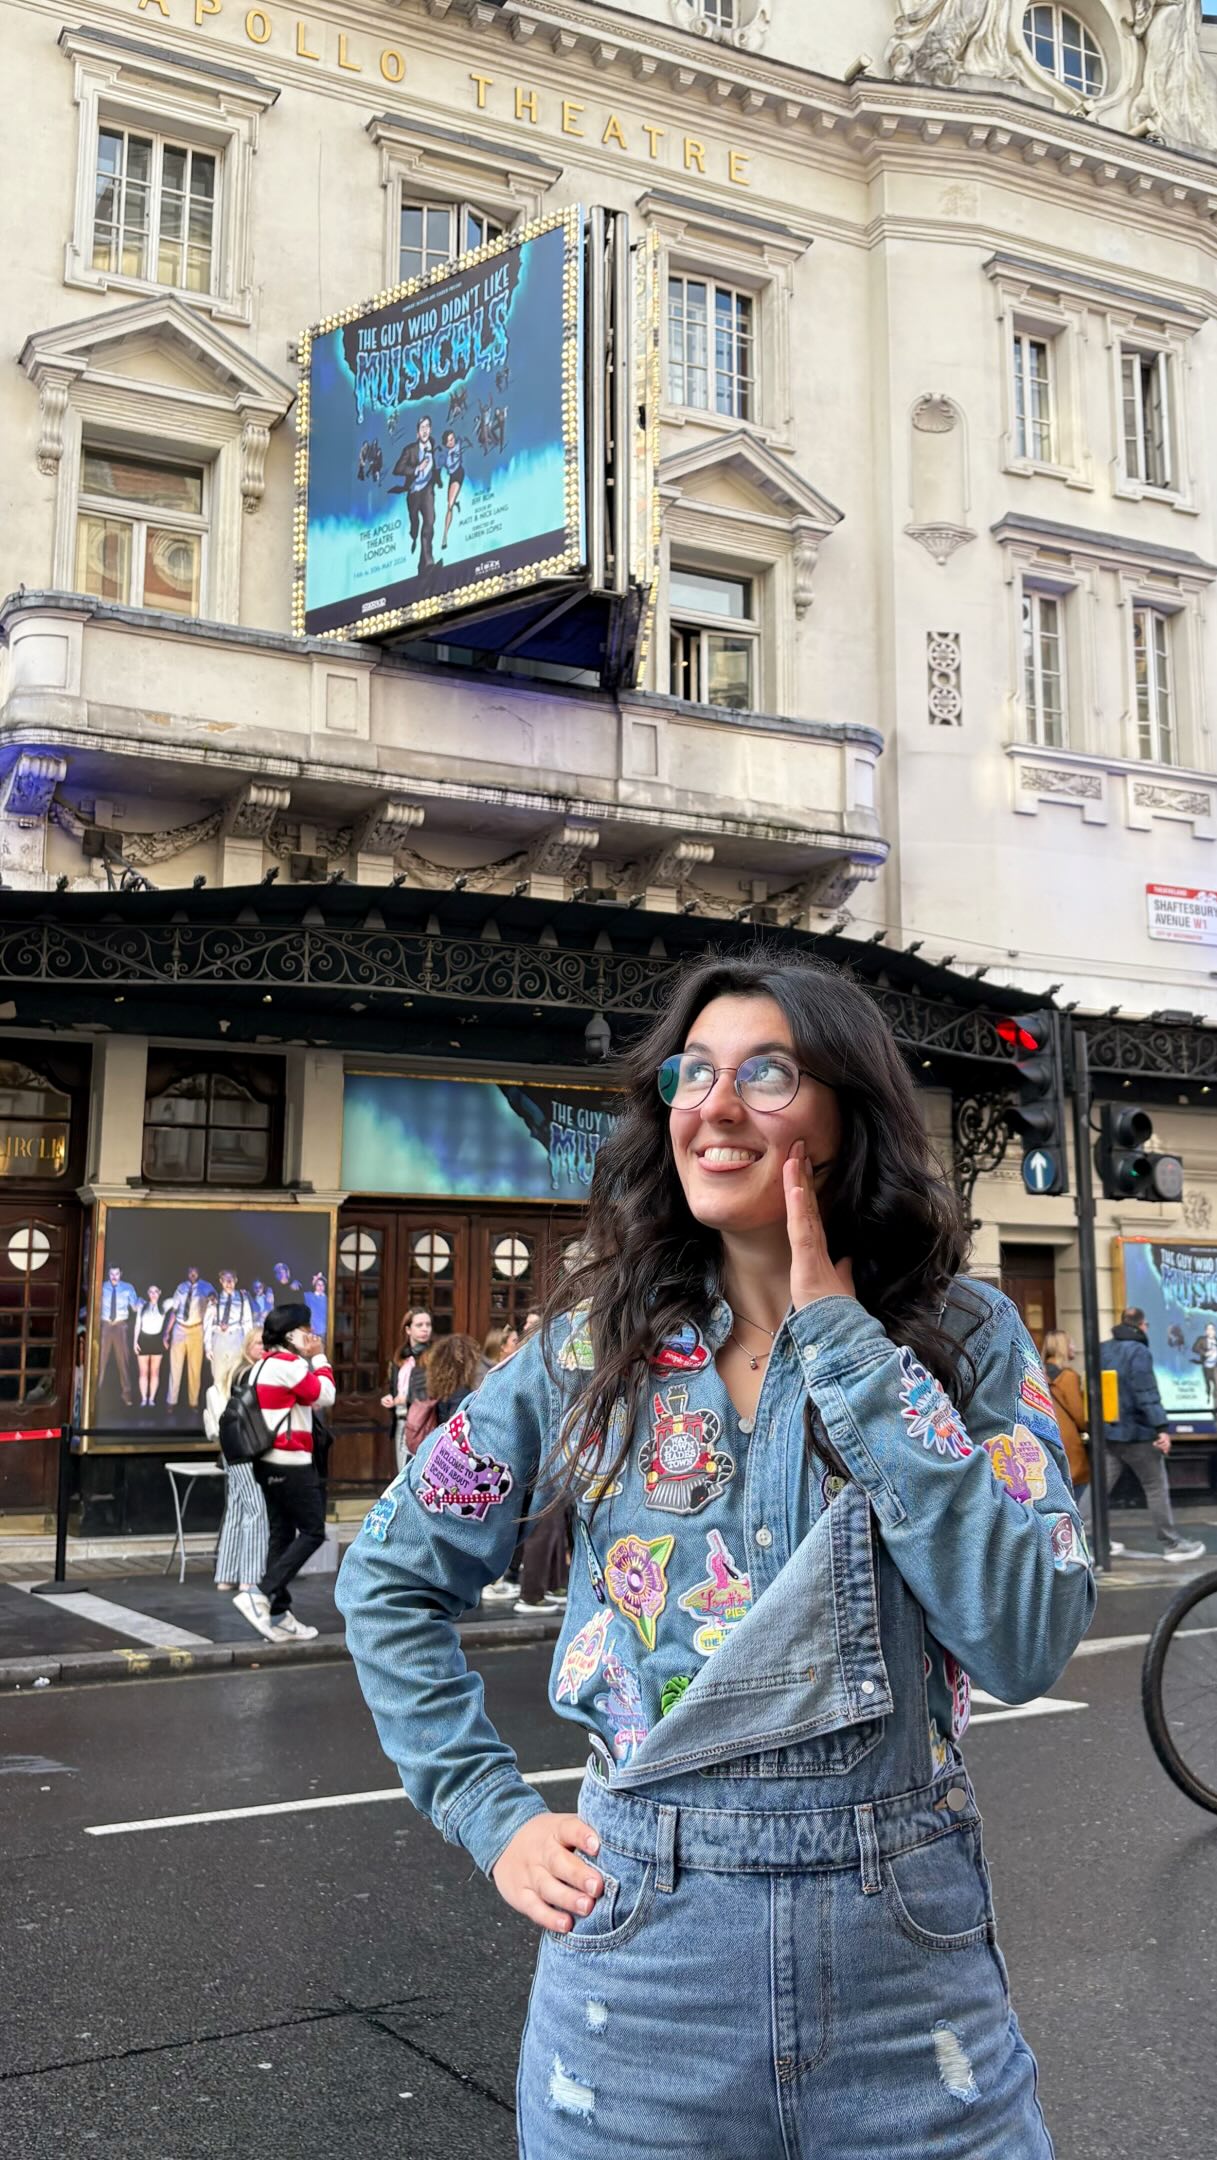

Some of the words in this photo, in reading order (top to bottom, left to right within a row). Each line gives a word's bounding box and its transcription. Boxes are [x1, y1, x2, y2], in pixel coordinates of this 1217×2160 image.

[470, 73, 750, 186] THEATRE
[358, 327, 378, 350] THE
[380, 319, 404, 346] GUY
[407, 309, 437, 339] WHO
[441, 284, 481, 326] DIDN'T
[484, 263, 510, 302] LIKE
[355, 290, 510, 424] MUSICALS
[360, 529, 371, 541] THE
[373, 519, 402, 536] APOLLO
[367, 532, 393, 549] THEATRE
[364, 543, 396, 561] LONDON
[1155, 913, 1191, 928] AVENUE
[1193, 917, 1207, 929] W1
[552, 1101, 573, 1126] THE
[577, 1108, 602, 1132] GUY
[1160, 1248, 1175, 1266] THE
[1176, 1253, 1192, 1269] GUY
[664, 1441, 696, 1453] DOWN
[671, 1435, 689, 1444] WAY
[440, 1446, 465, 1473] WELCOME
[465, 1468, 474, 1479] TO
[472, 1474, 479, 1483] A
[664, 1449, 697, 1462] HADES
[667, 1459, 693, 1468] TOWN
[434, 1455, 451, 1473] SHOW
[449, 1470, 470, 1488] ABOUT
[725, 1607, 747, 1618] PIES
